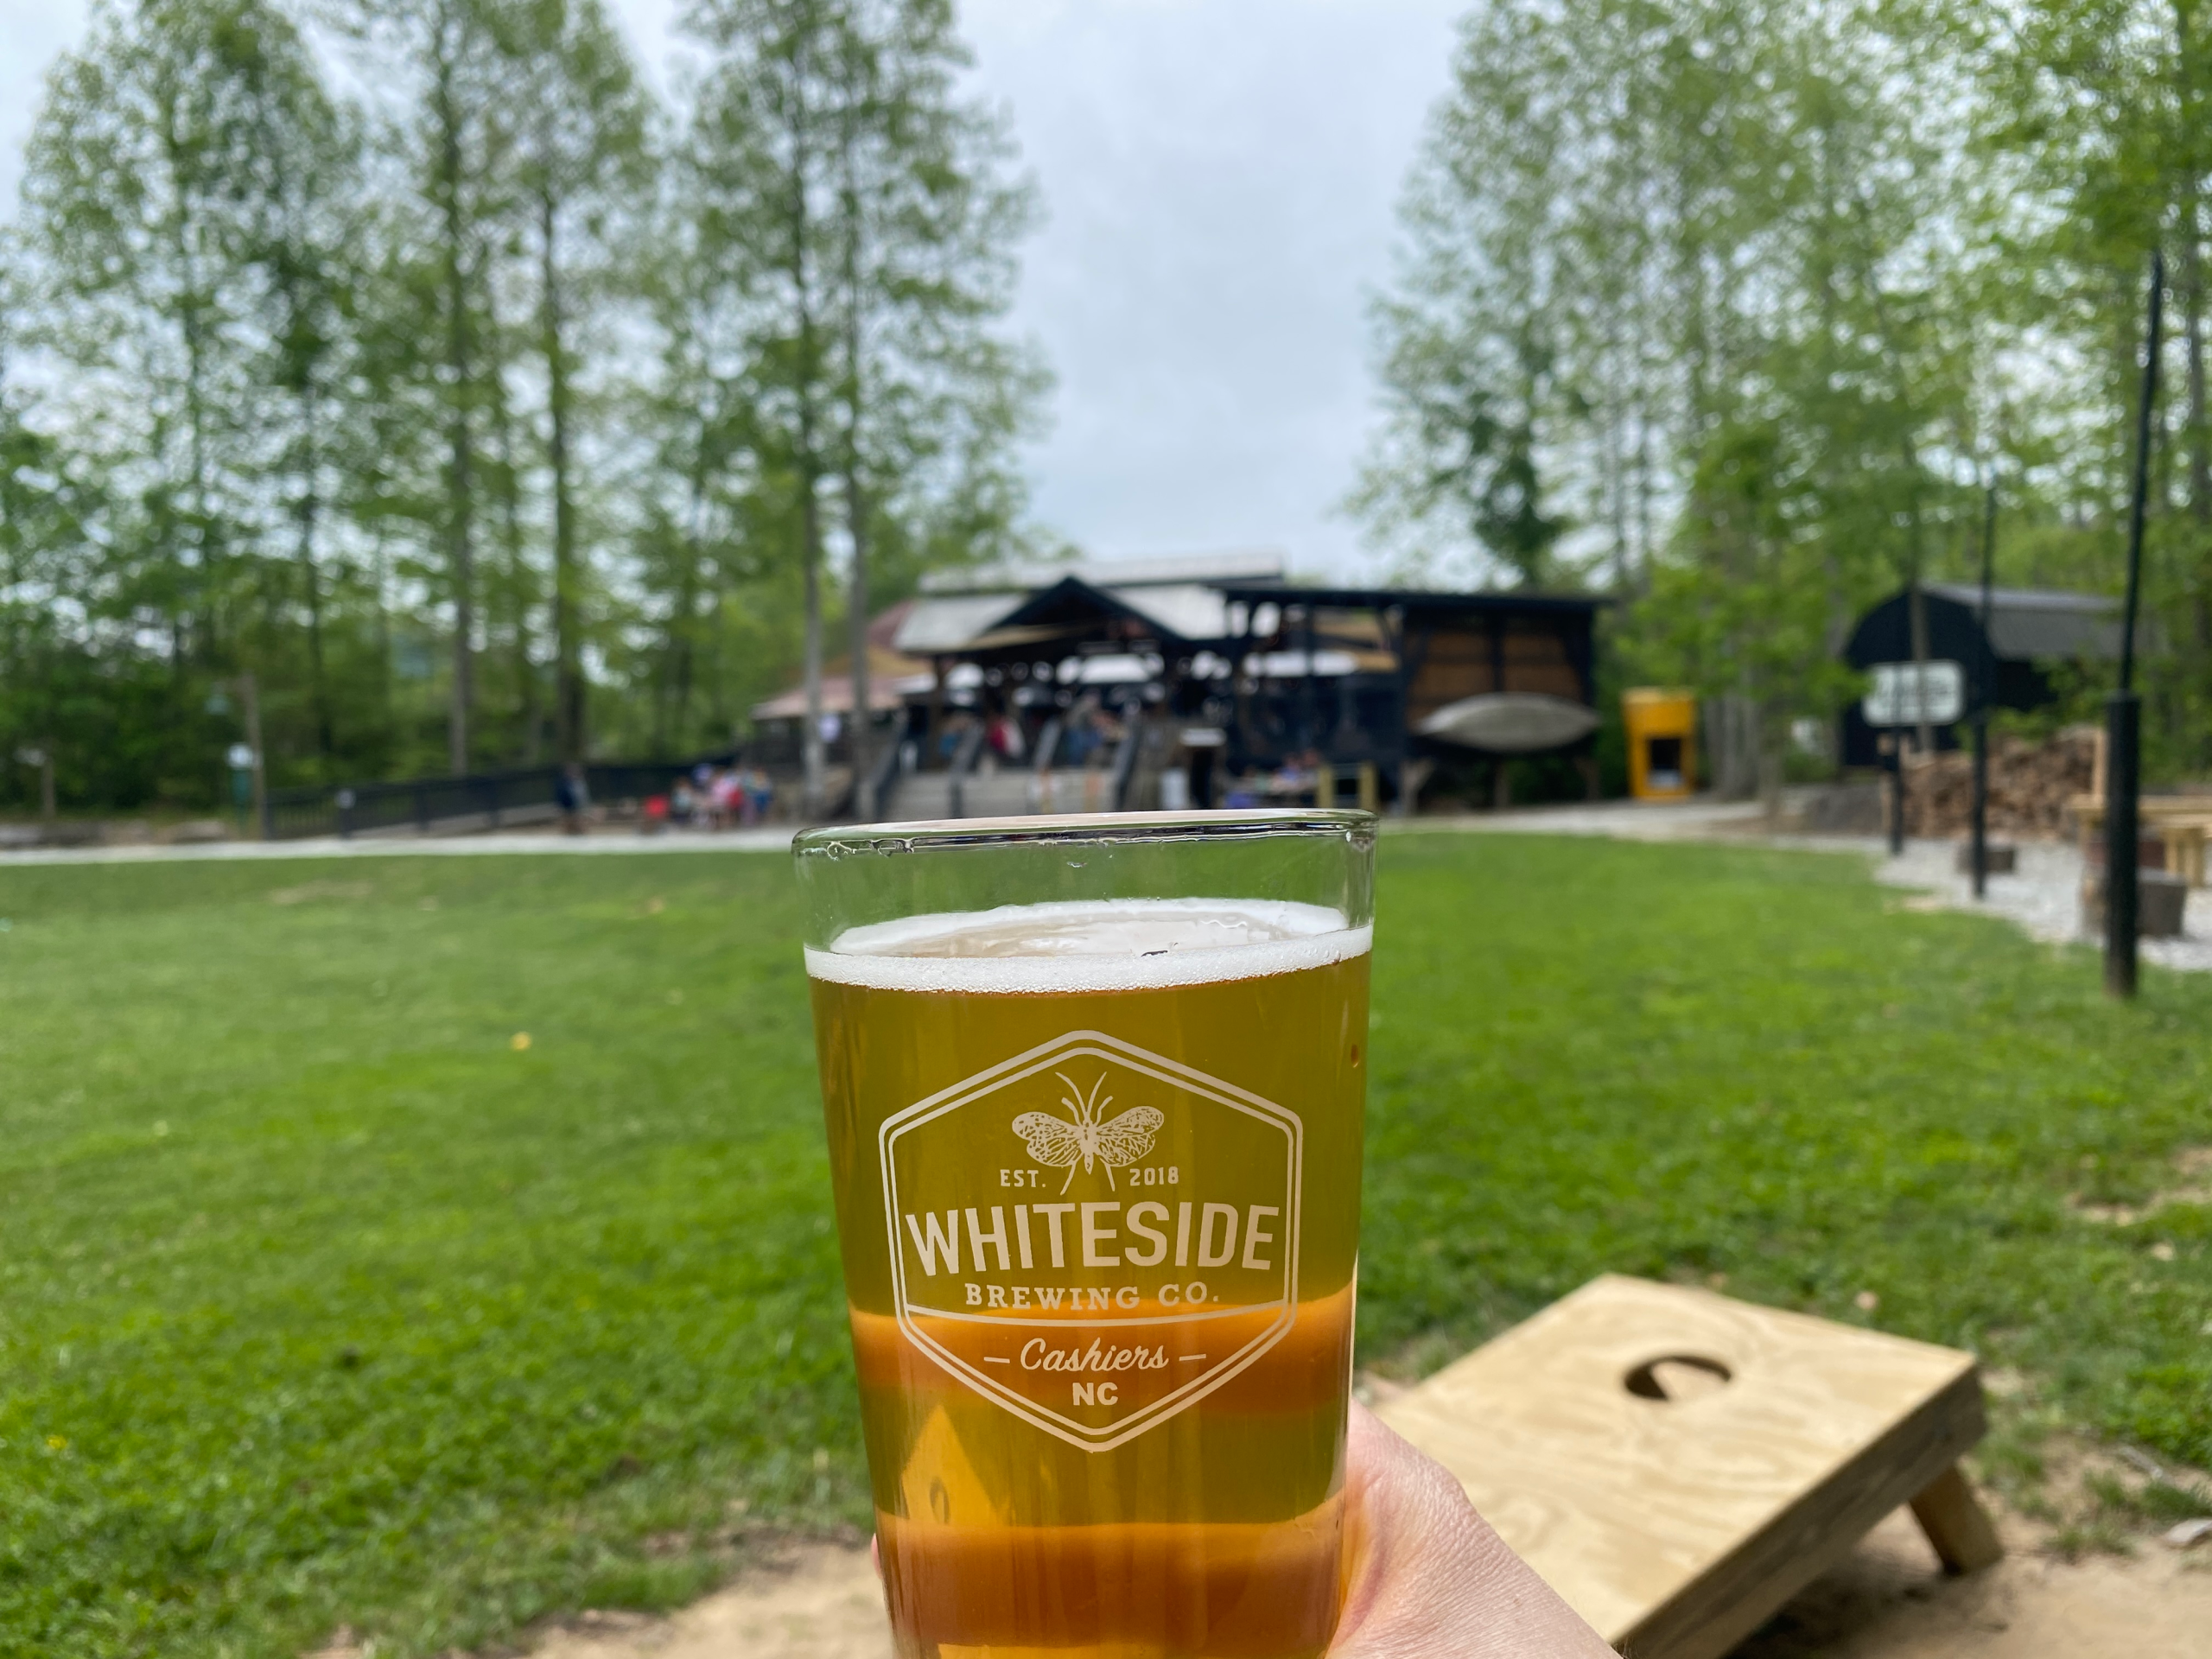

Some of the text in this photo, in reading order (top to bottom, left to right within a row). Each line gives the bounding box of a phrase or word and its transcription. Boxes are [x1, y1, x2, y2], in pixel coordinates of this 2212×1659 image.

[1000, 1166, 1179, 1188] EST. 2018
[905, 1201, 1280, 1277] WHITESIDE
[964, 1281, 1220, 1310] BREWING CO.
[1020, 1337, 1170, 1372] Cashiers
[1072, 1382, 1119, 1406] NC
